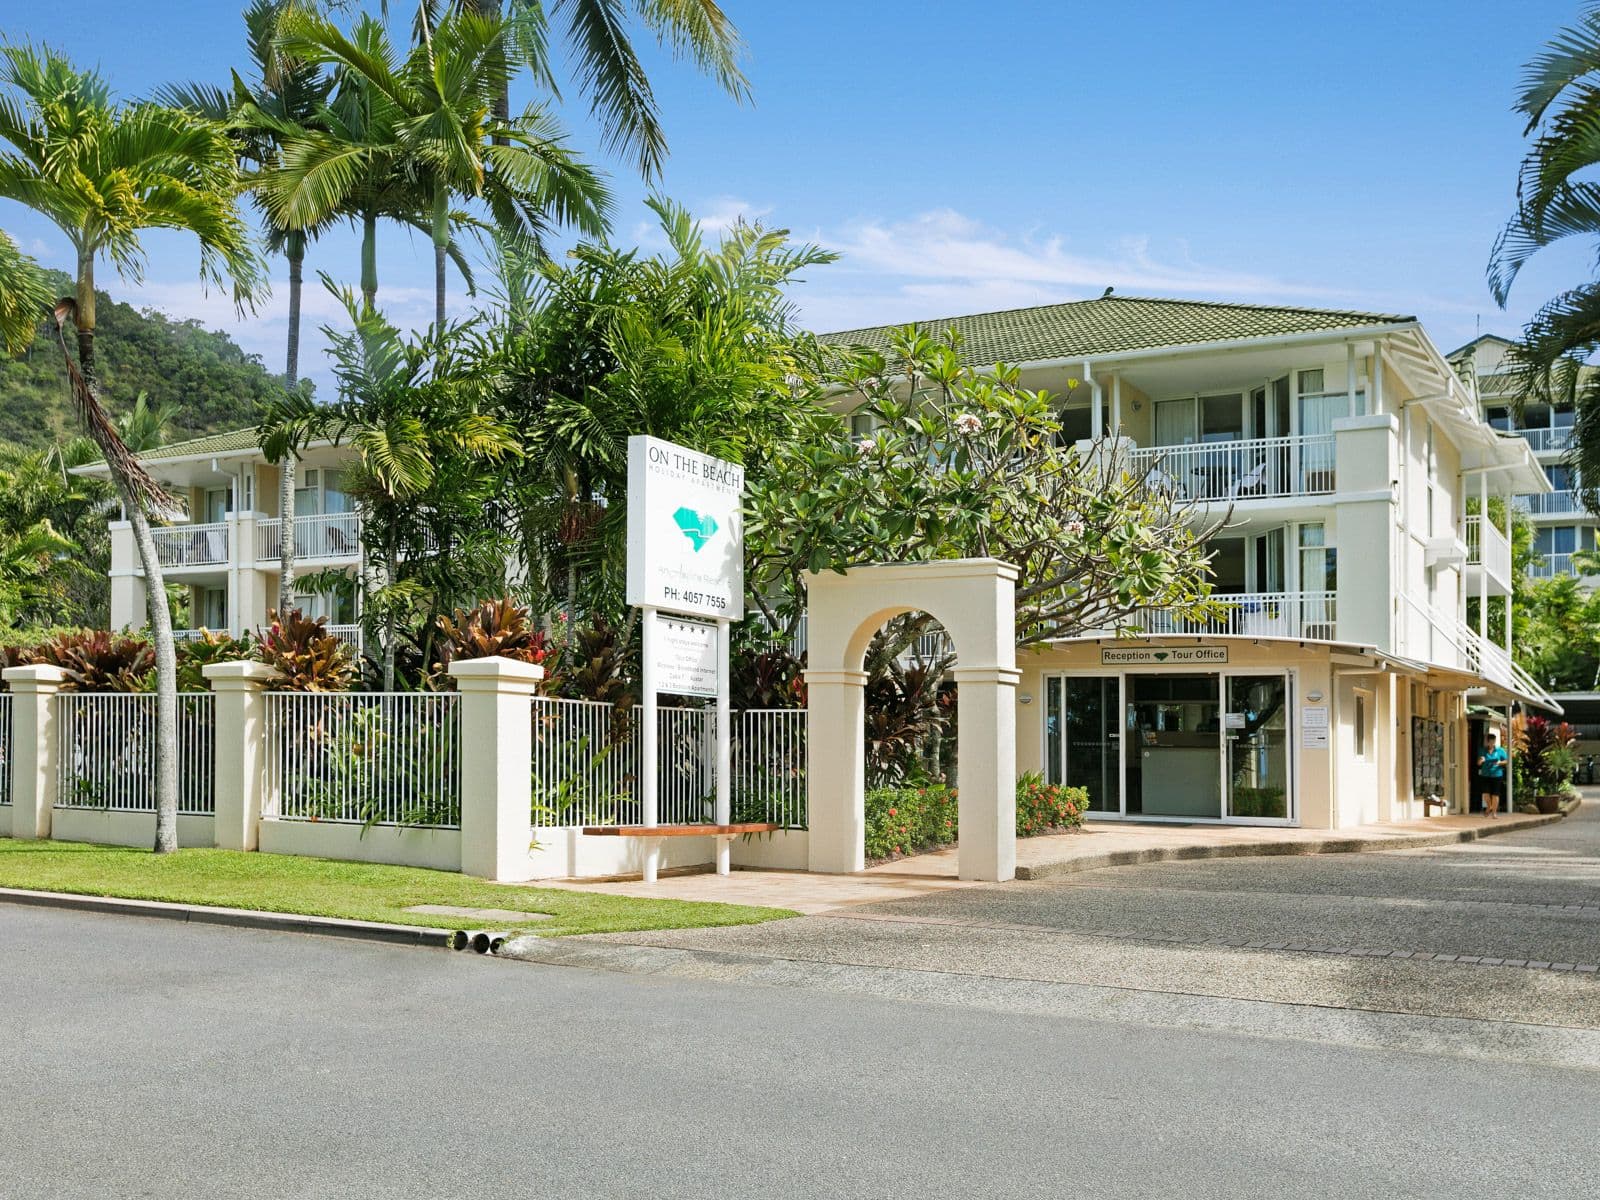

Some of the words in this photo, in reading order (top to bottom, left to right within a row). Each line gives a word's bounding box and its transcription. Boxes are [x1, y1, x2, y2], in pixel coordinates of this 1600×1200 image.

[649, 446, 669, 466] ON
[674, 454, 698, 475] THE
[702, 464, 740, 488] BEACH
[664, 586, 681, 601] PH:
[683, 590, 703, 606] 4057
[706, 594, 726, 609] 7555
[1104, 651, 1151, 661] Reception
[1171, 650, 1192, 659] Tour
[1195, 650, 1225, 659] Office
